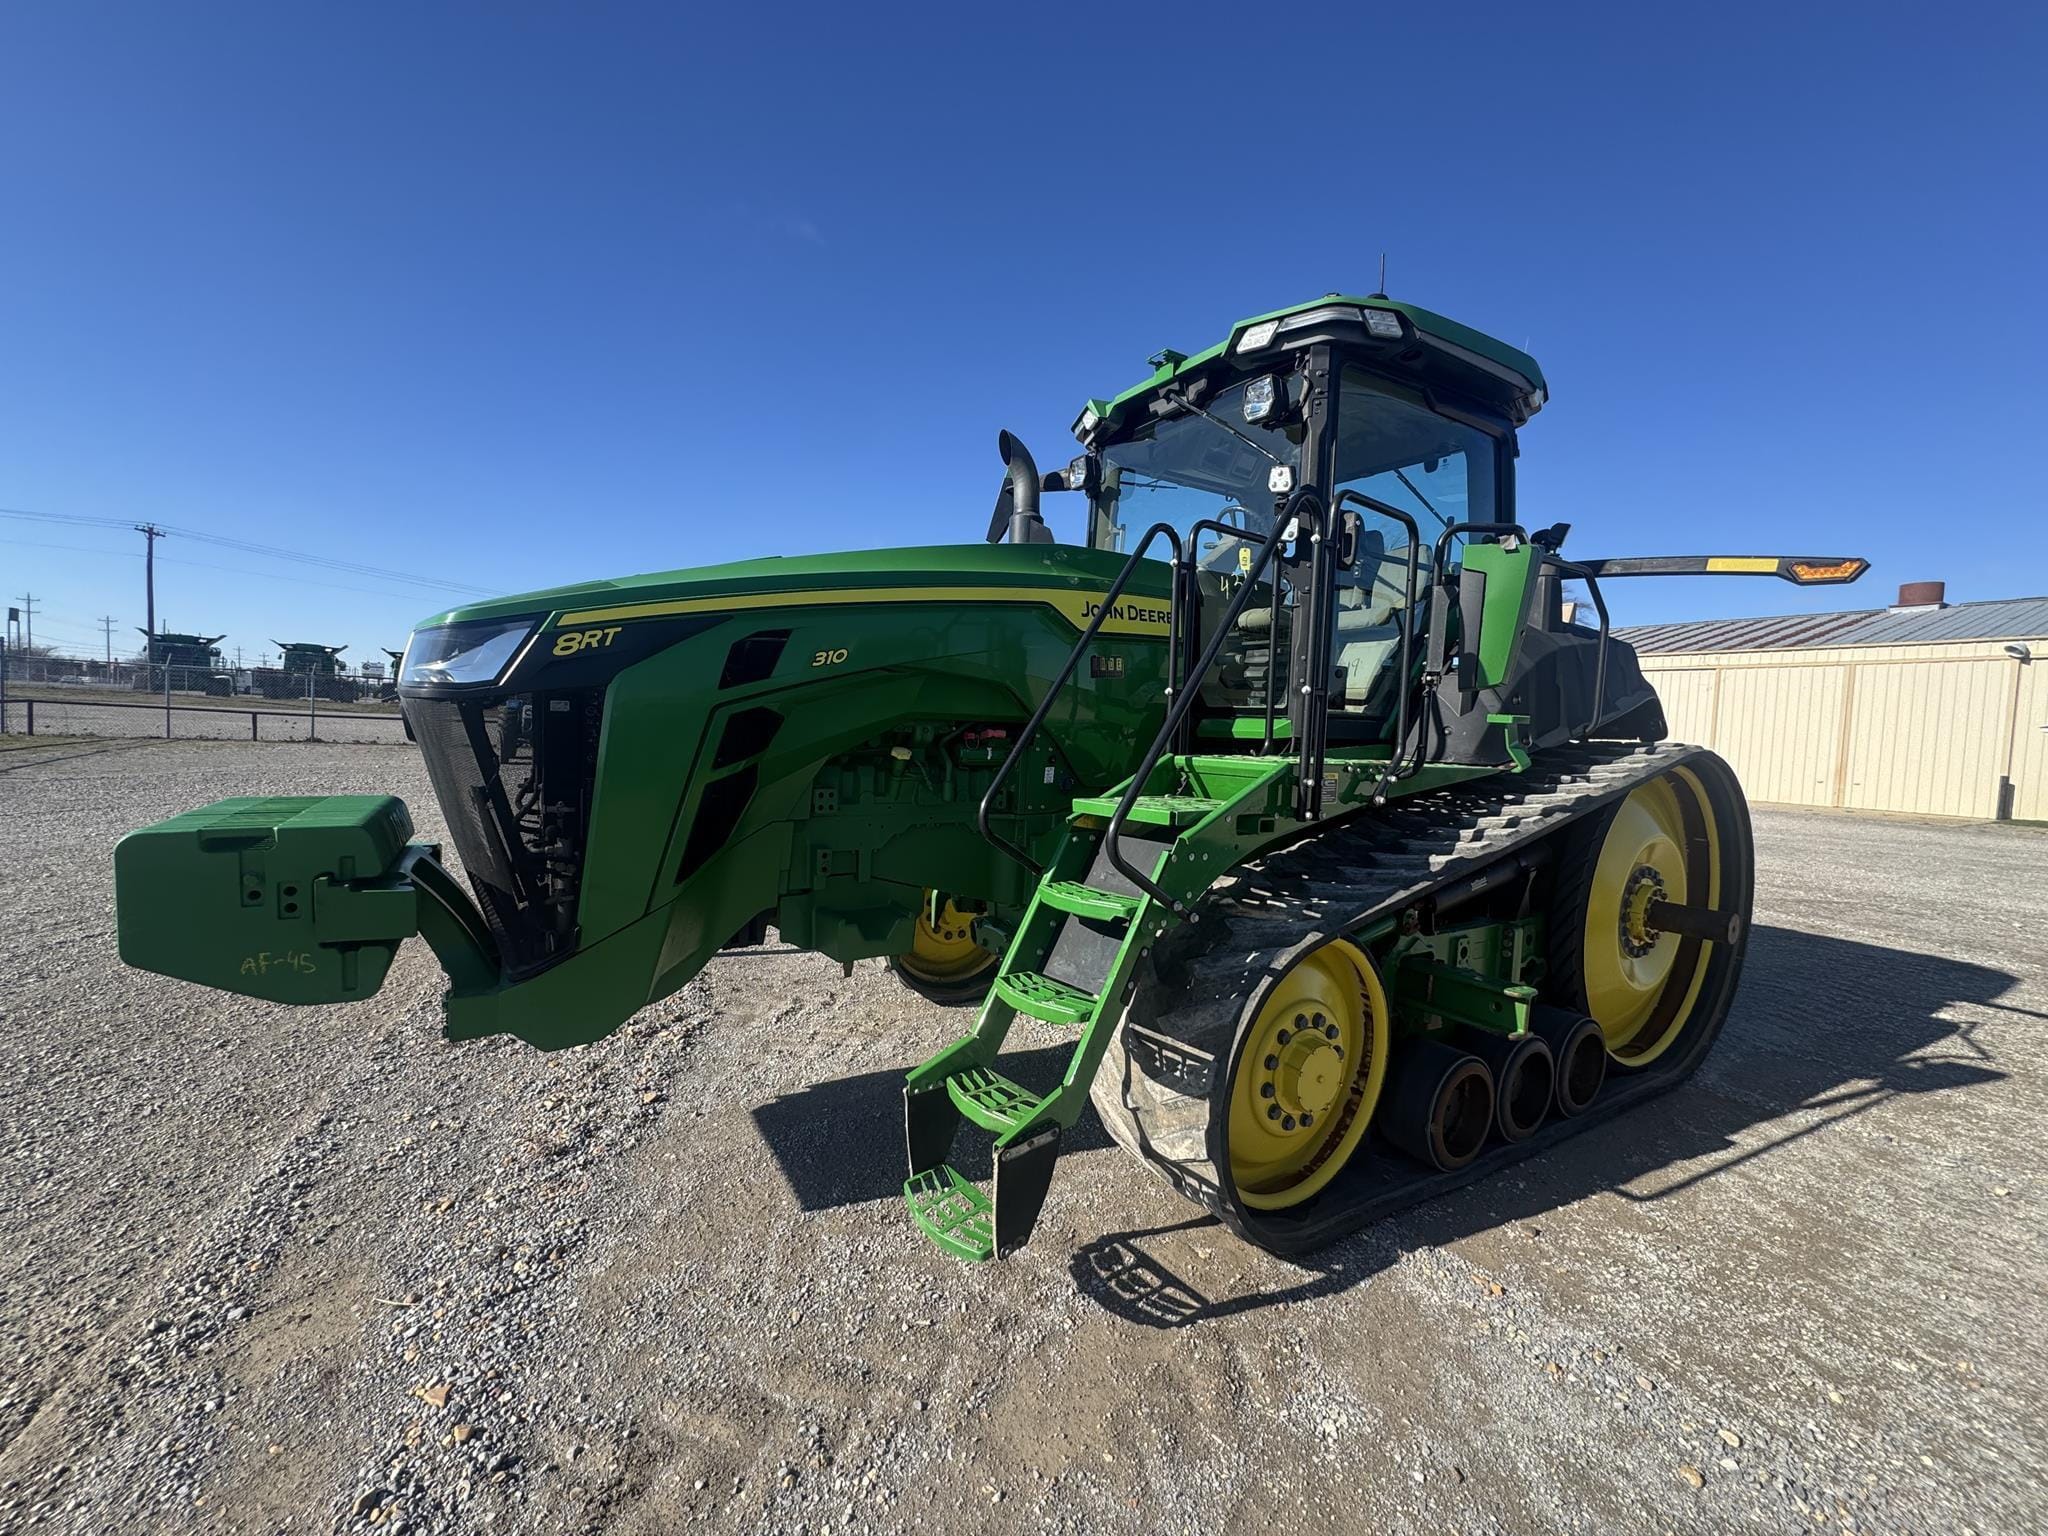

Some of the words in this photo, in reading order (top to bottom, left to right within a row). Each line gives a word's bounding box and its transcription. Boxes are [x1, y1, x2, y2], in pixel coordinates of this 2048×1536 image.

[1127, 604, 1172, 625] DEERE
[552, 627, 622, 656] 8RT
[812, 648, 848, 667] 310
[240, 950, 317, 976] AF-45
